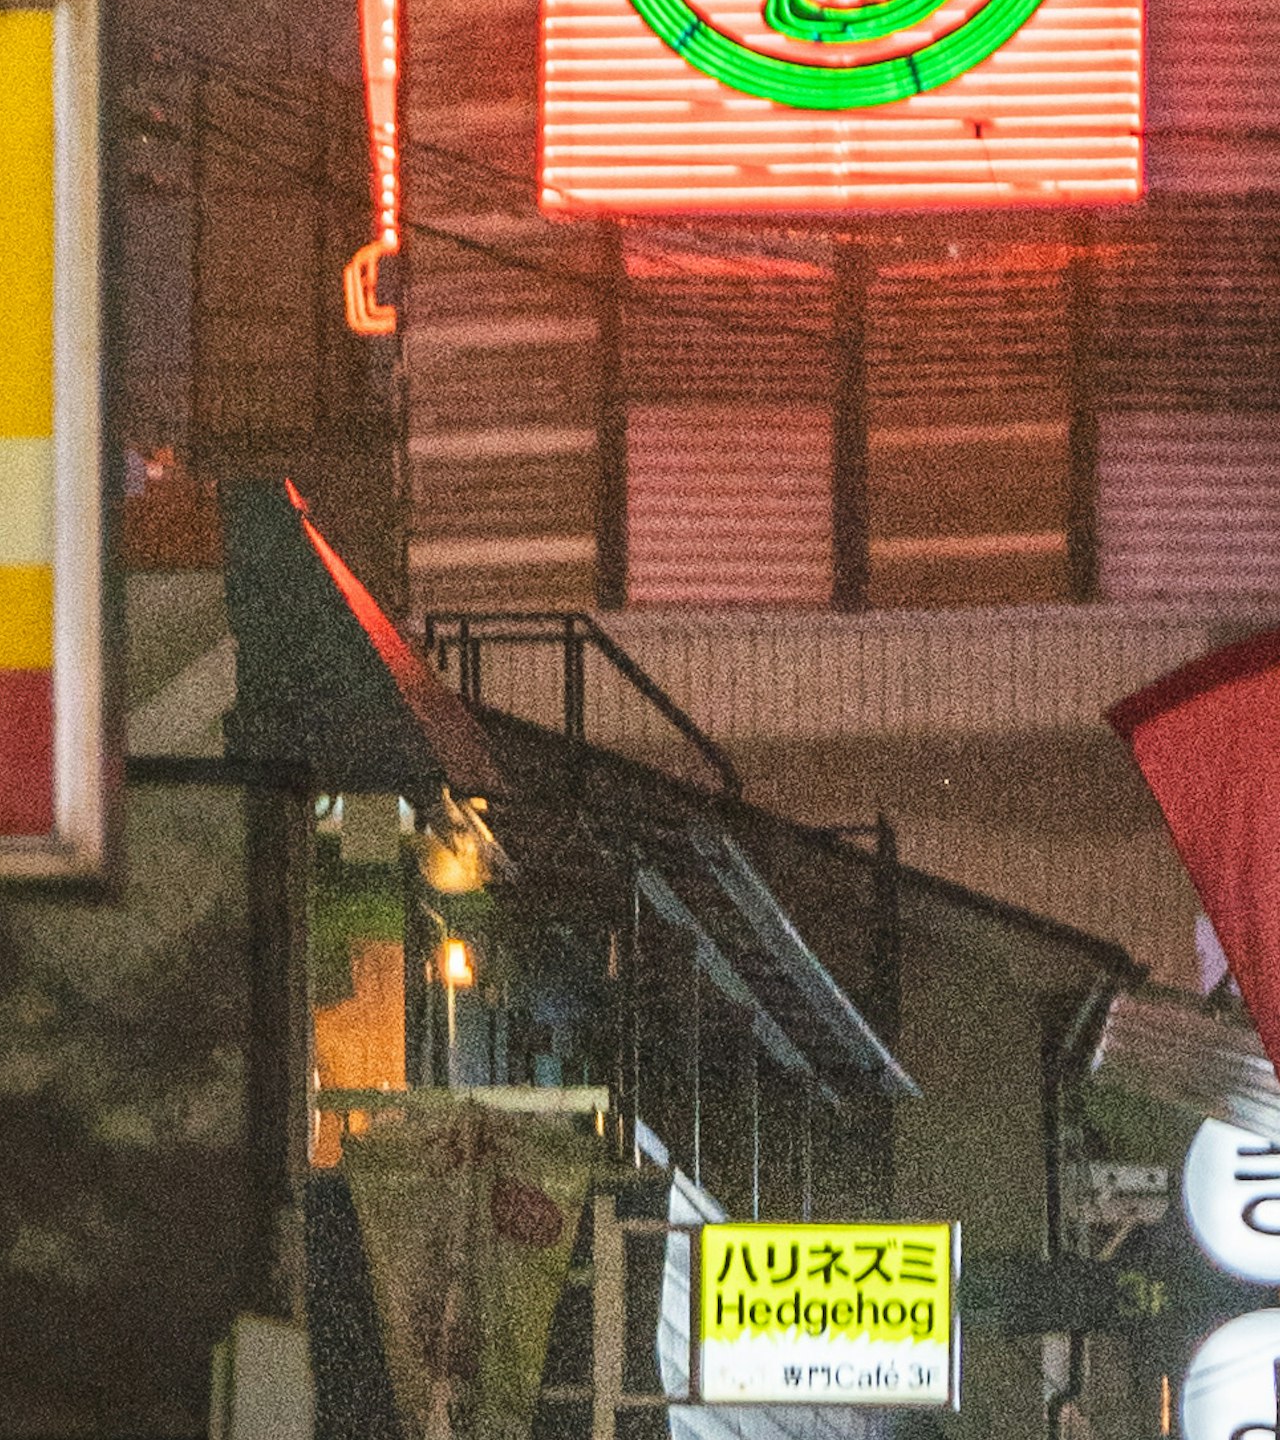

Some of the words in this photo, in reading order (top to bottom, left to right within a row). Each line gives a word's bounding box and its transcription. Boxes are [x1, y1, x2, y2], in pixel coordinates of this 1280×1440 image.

[717, 1238, 937, 1284] ハリネズミ
[715, 1290, 934, 1336] Hedgehog
